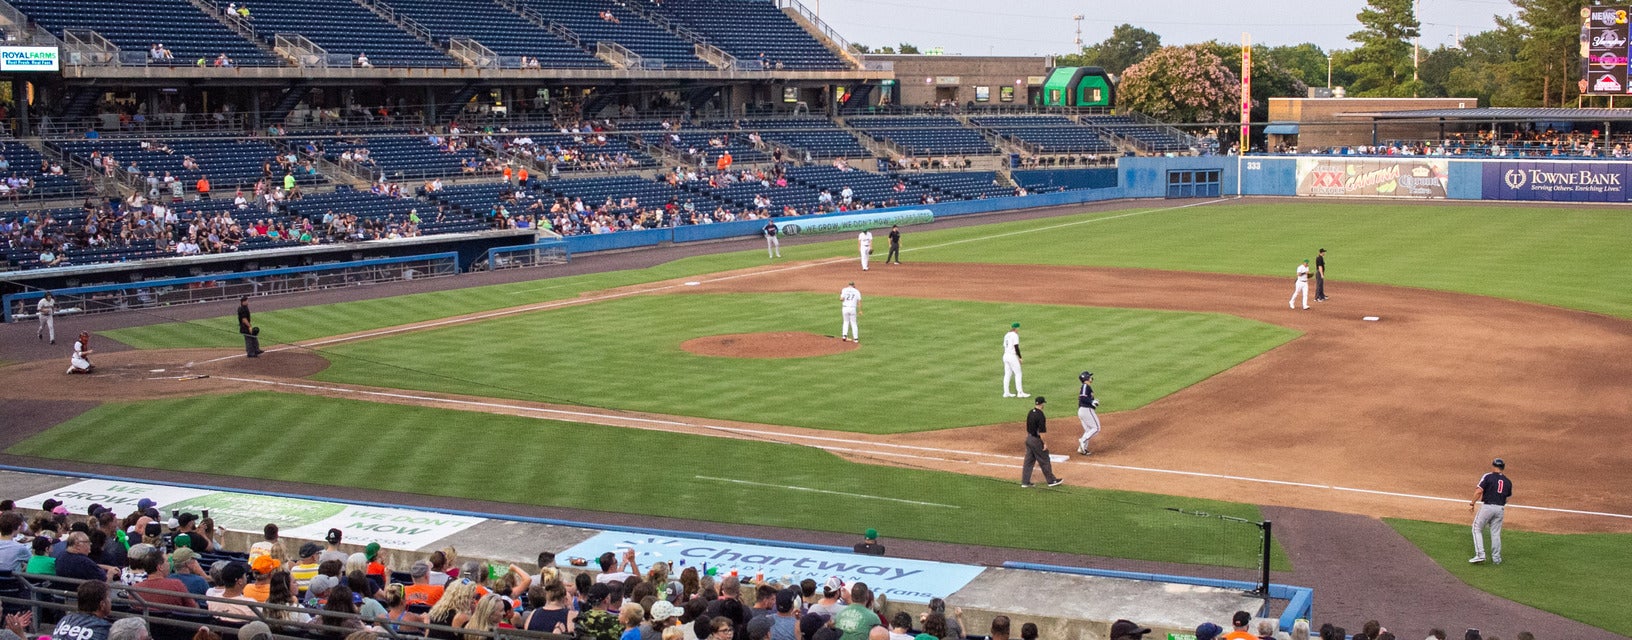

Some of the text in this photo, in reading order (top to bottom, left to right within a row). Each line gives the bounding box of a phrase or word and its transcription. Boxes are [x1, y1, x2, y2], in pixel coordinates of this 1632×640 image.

[1592, 10, 1627, 24] NEWS 3
[1312, 171, 1345, 188] XX
[1529, 169, 1621, 185] TOWNE BANK
[107, 485, 153, 494] WE
[1497, 479, 1504, 494] 1
[350, 510, 393, 520] WE
[345, 521, 433, 536] MOW
[679, 546, 925, 582] Chartway
[53, 620, 94, 640] Jeep
